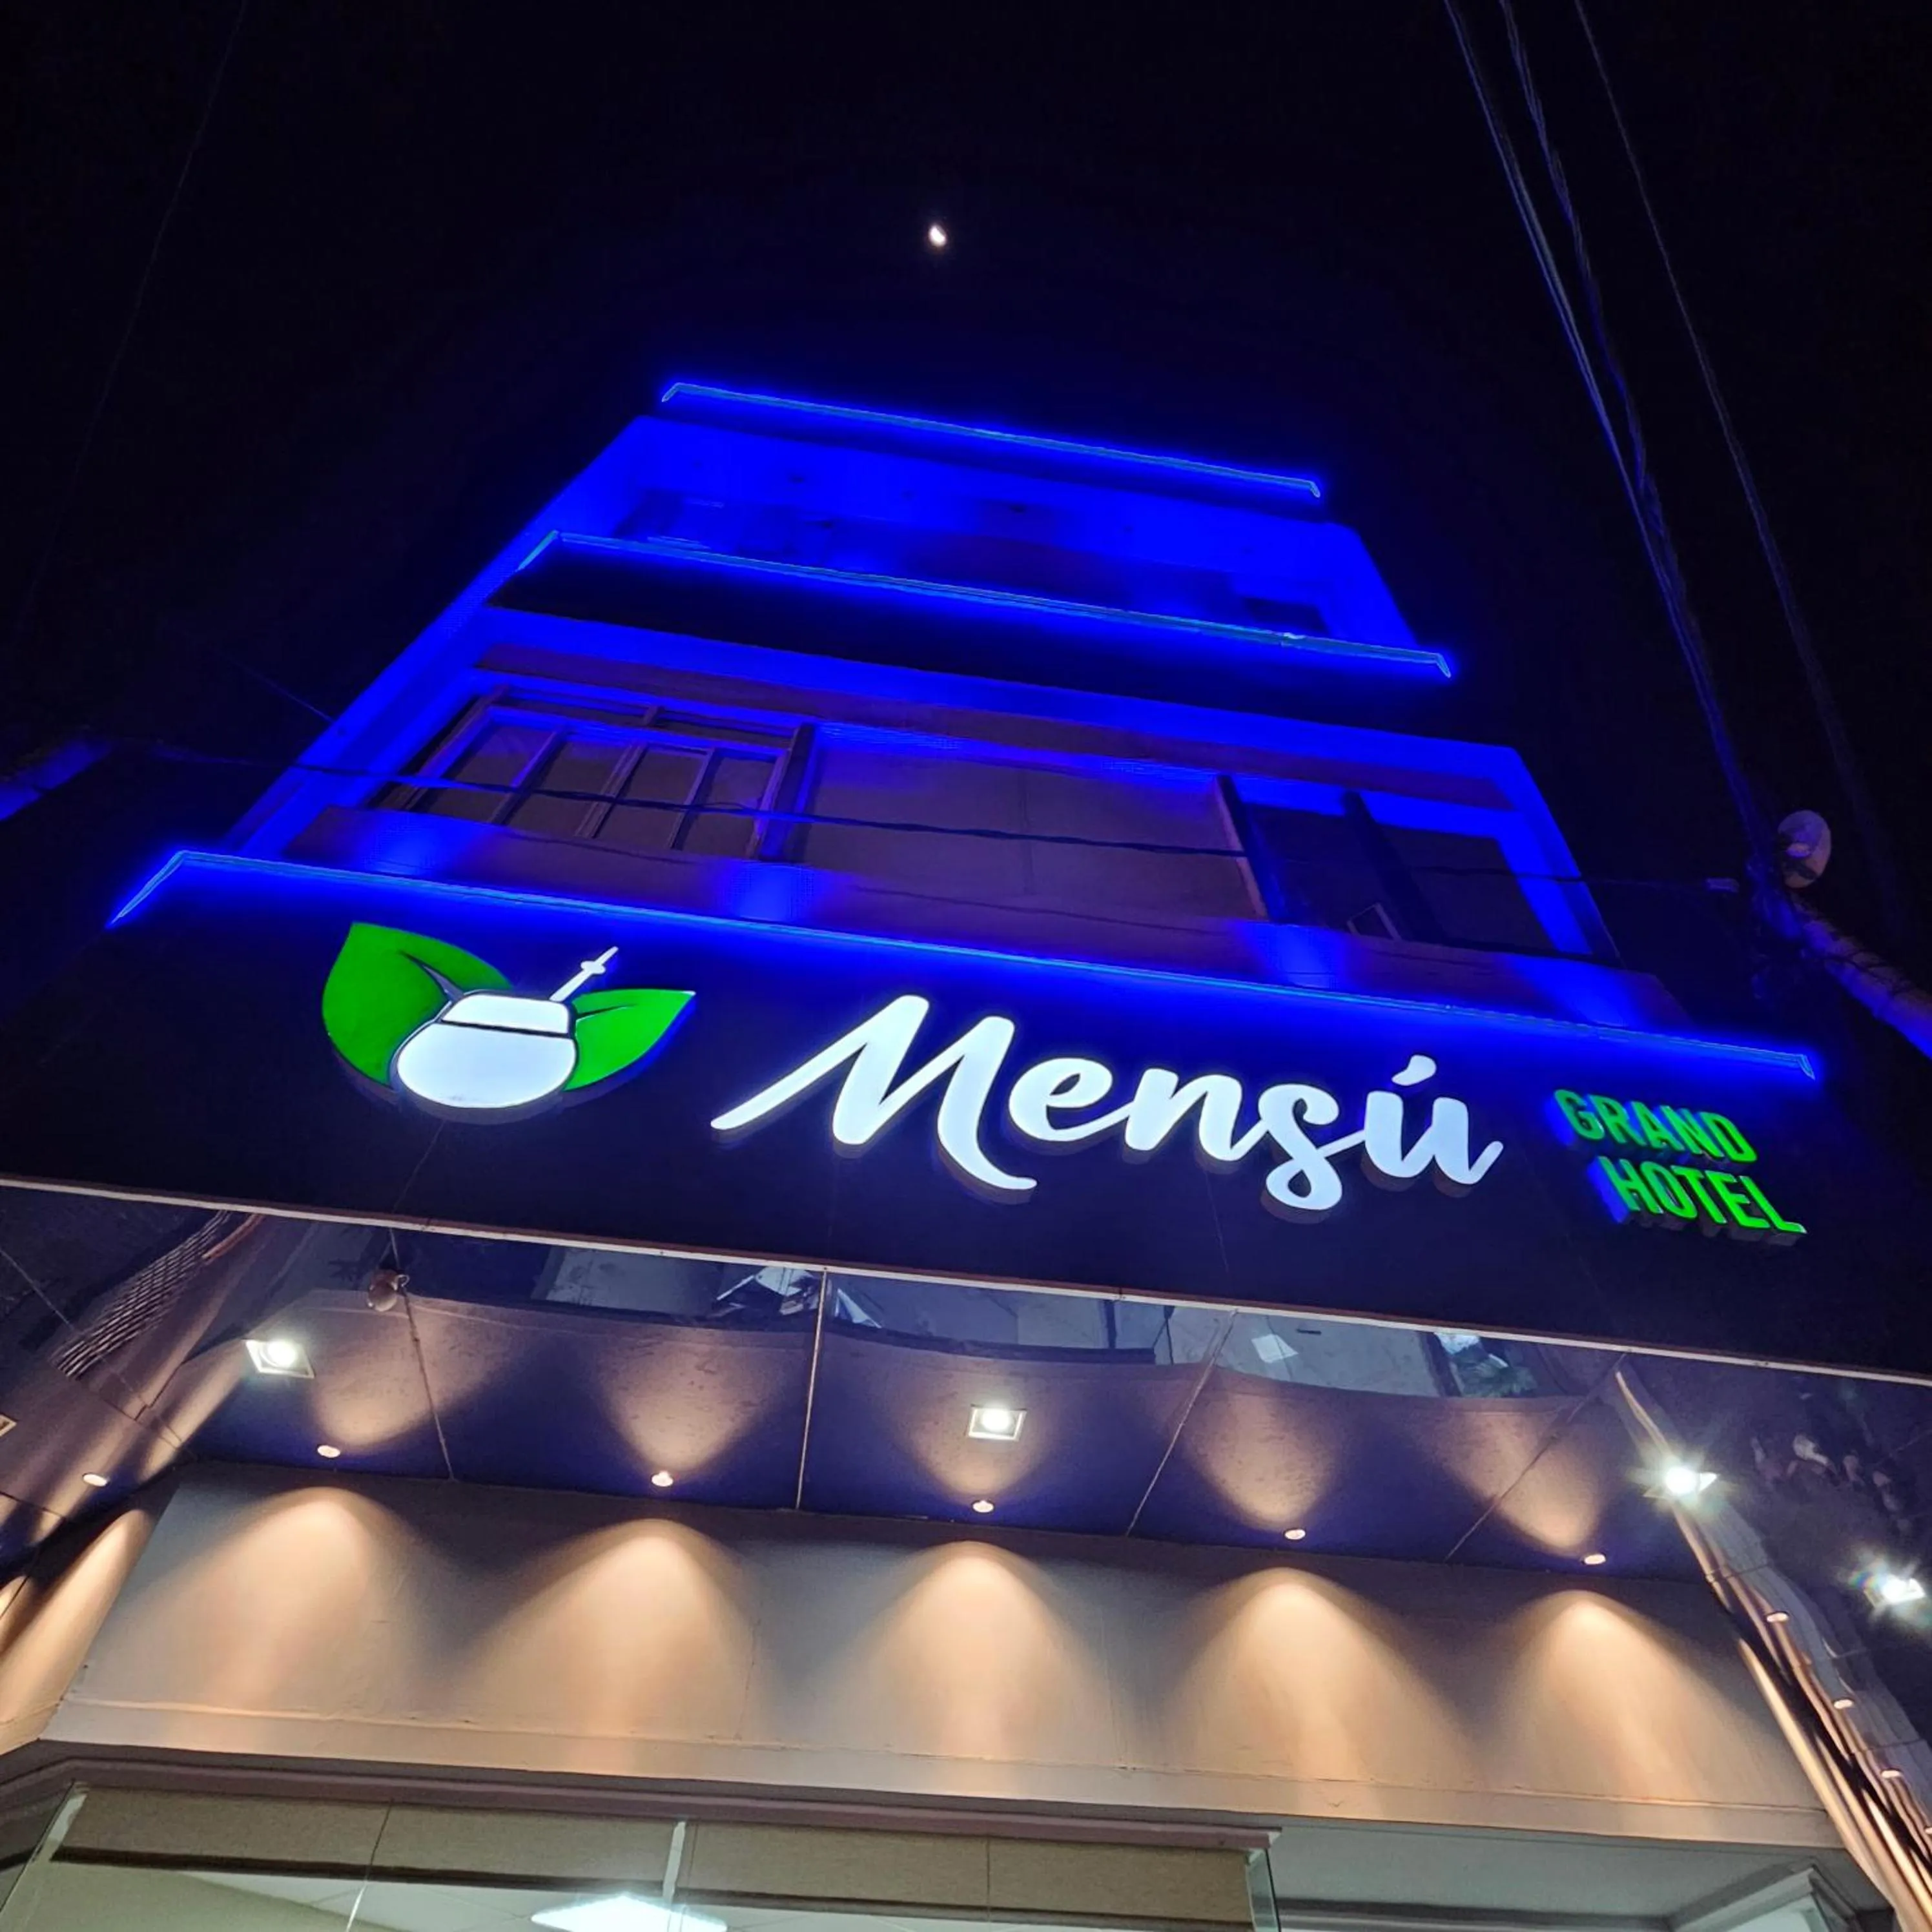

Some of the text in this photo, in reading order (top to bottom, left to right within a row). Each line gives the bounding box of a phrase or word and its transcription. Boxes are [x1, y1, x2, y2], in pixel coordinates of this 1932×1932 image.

[710, 994, 1503, 1211] Mensú
[1554, 1089, 1757, 1162] GRAND
[1598, 1156, 1807, 1234] HOTEL
